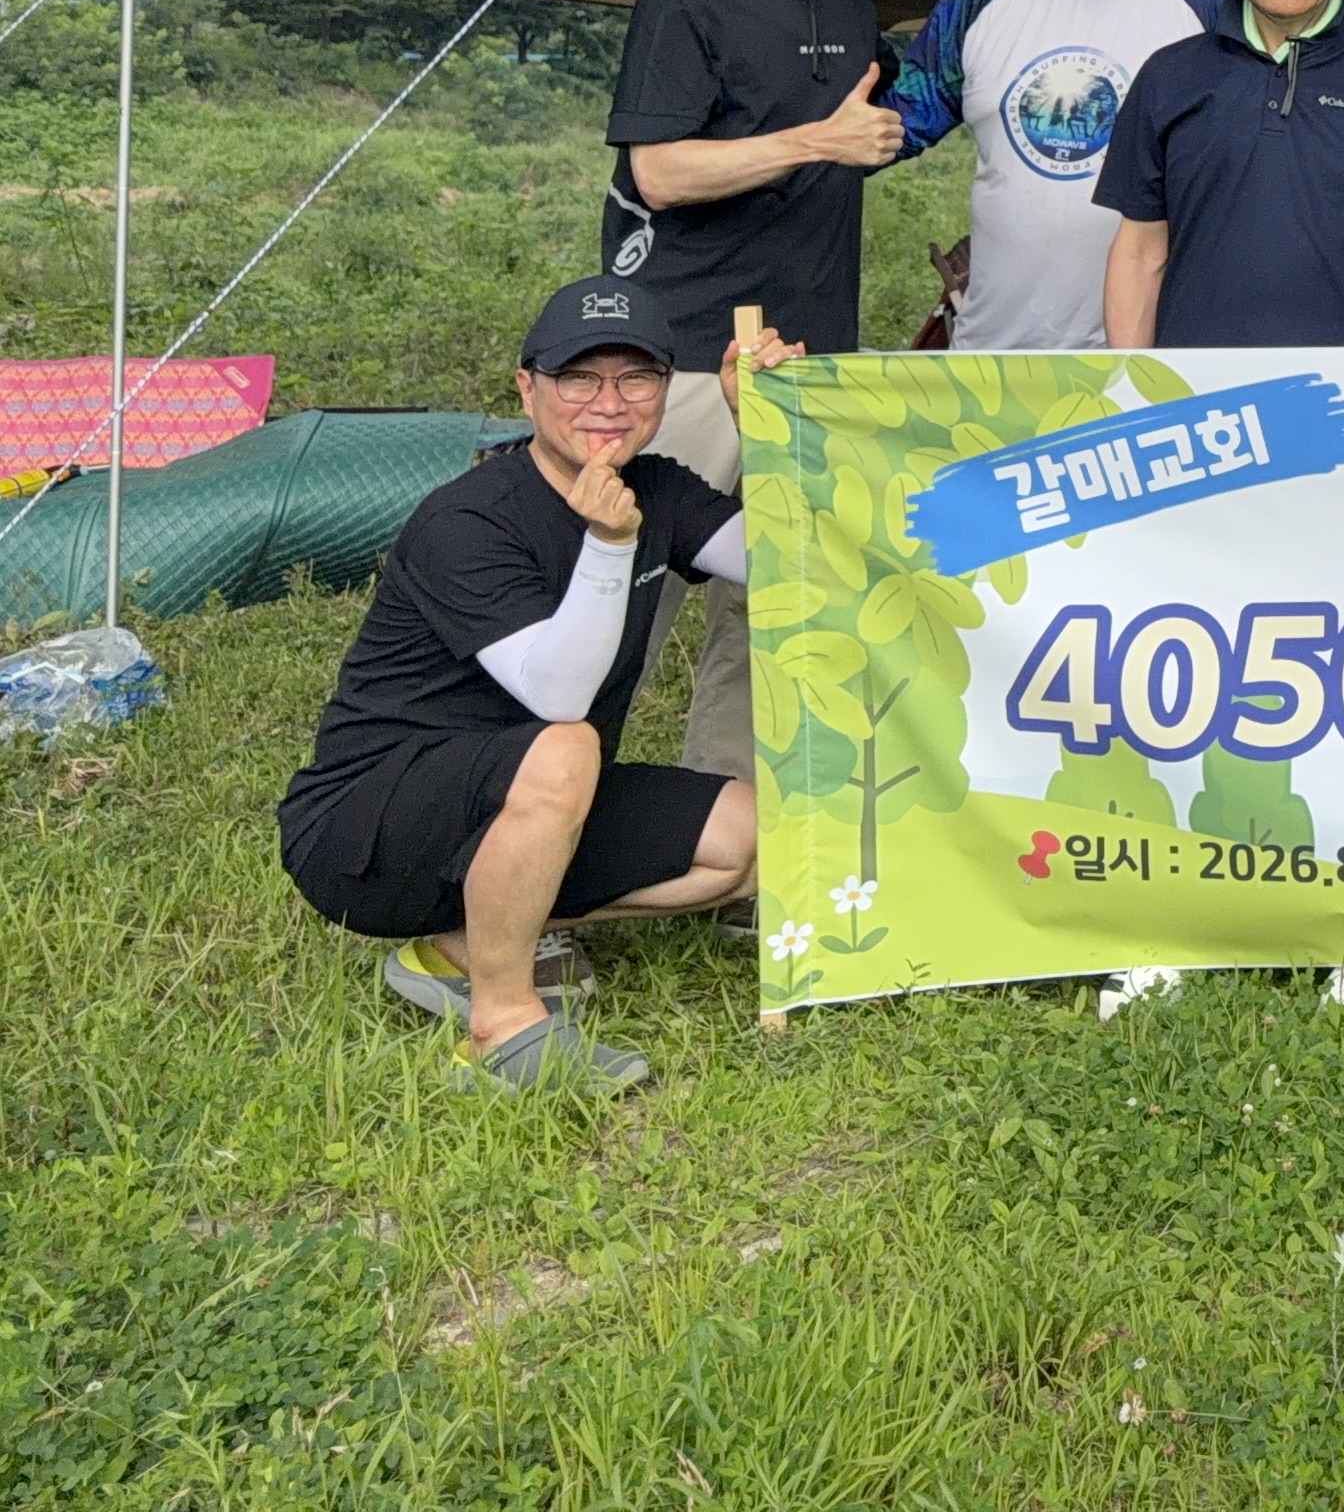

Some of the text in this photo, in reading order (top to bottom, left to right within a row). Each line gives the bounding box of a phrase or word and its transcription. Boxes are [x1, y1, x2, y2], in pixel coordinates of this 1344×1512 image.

[1031, 55, 1098, 77] SURFING
[1009, 84, 1025, 134] EARTH
[993, 404, 1270, 533] 갈매교회
[1065, 834, 1151, 882] 일시
